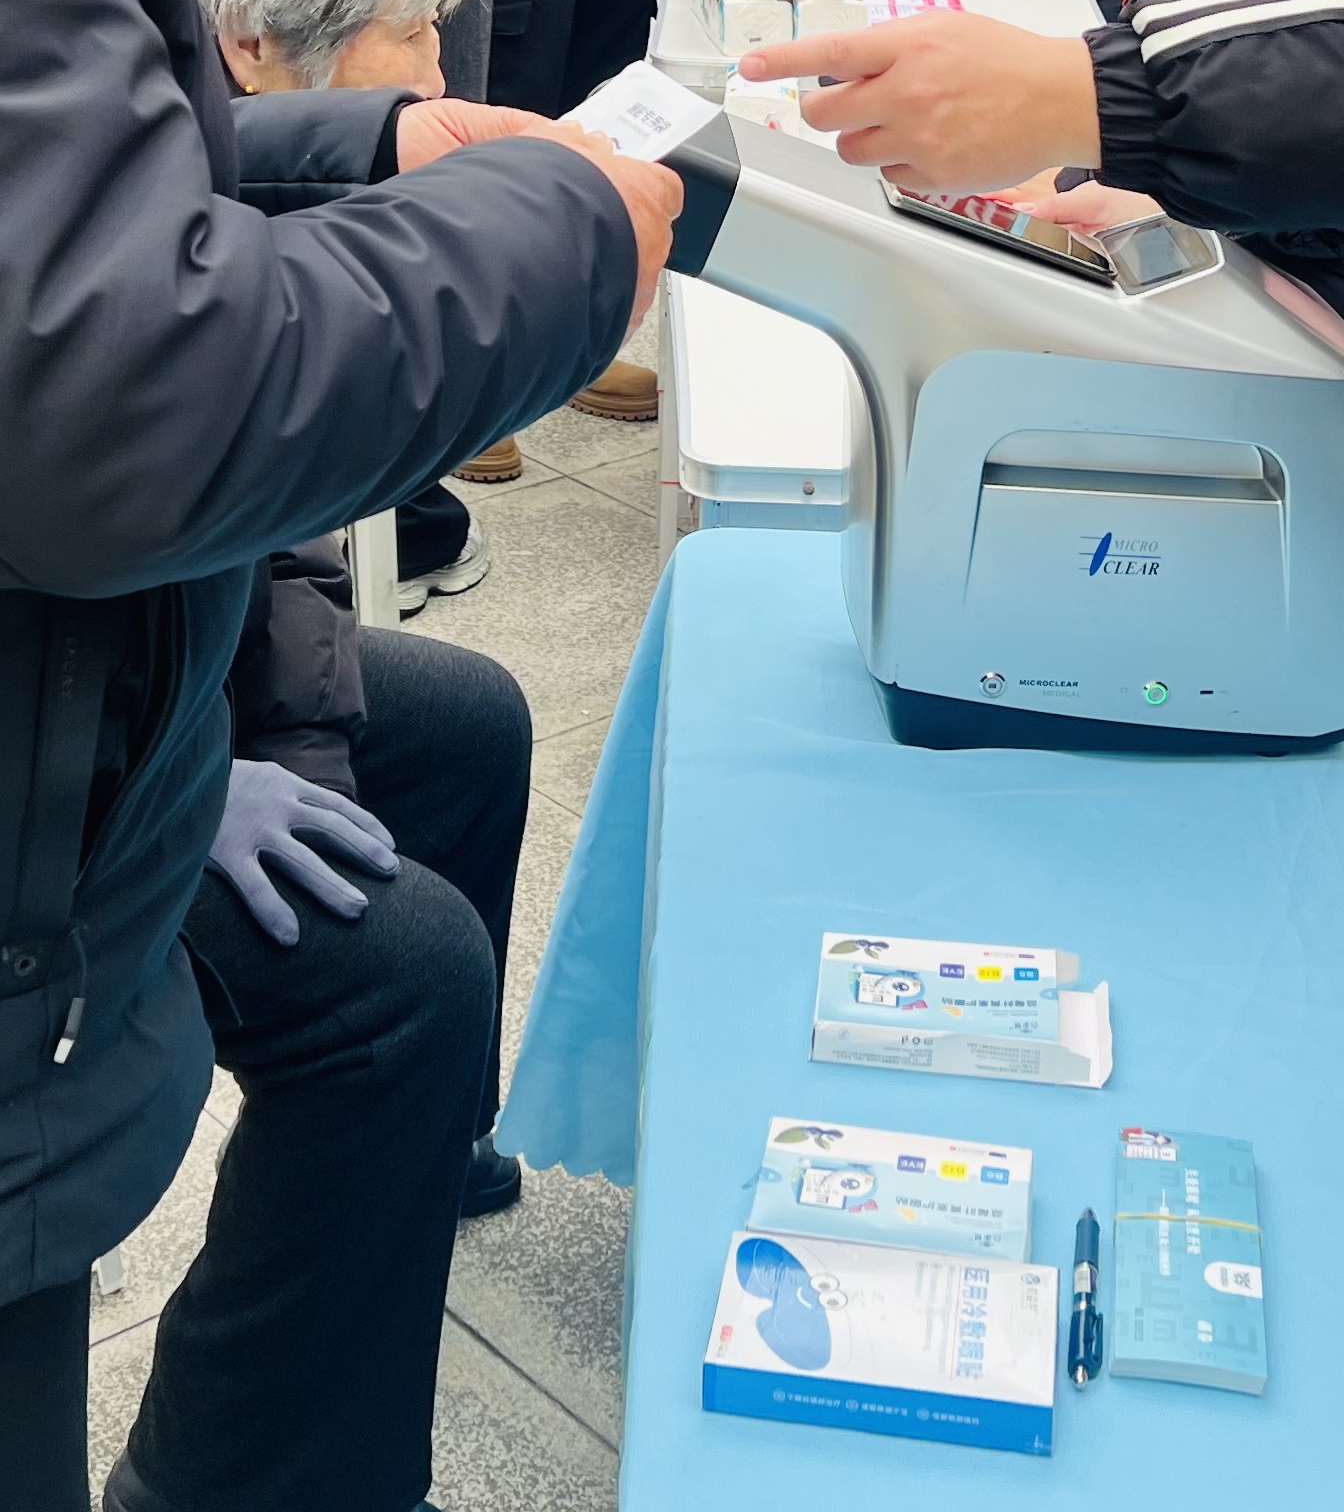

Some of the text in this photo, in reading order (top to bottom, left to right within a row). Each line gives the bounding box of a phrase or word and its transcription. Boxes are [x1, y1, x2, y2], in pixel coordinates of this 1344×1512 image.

[1114, 539, 1159, 553] MICRO
[1103, 560, 1161, 576] CLEAR
[1019, 679, 1079, 688] MICROCLEAR
[1042, 689, 1081, 699] MEDICAL
